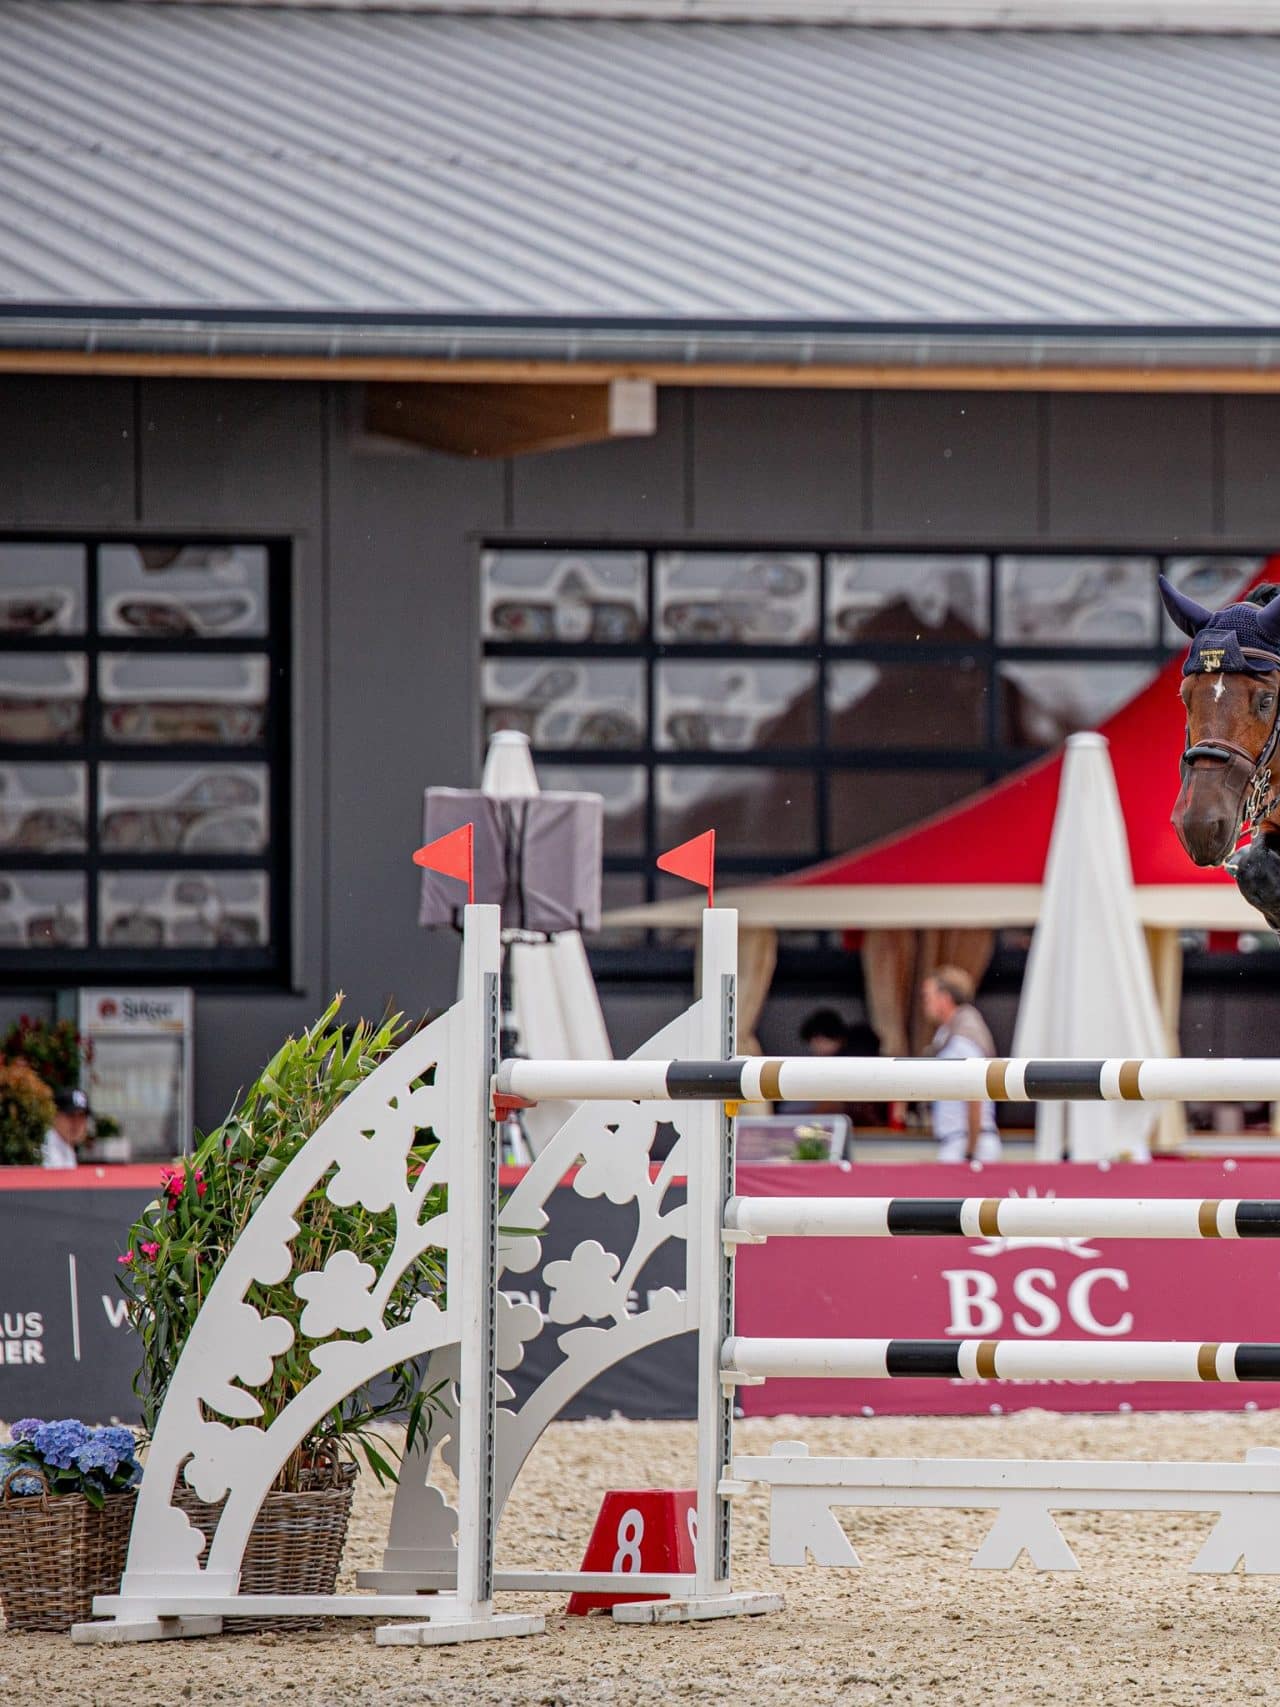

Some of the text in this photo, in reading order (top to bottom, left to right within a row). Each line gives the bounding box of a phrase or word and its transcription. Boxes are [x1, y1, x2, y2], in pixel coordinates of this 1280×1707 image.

[941, 1267, 1134, 1337] BSC
[0, 1312, 44, 1338] US
[0, 1340, 46, 1365] ER
[612, 1508, 645, 1573] 8
